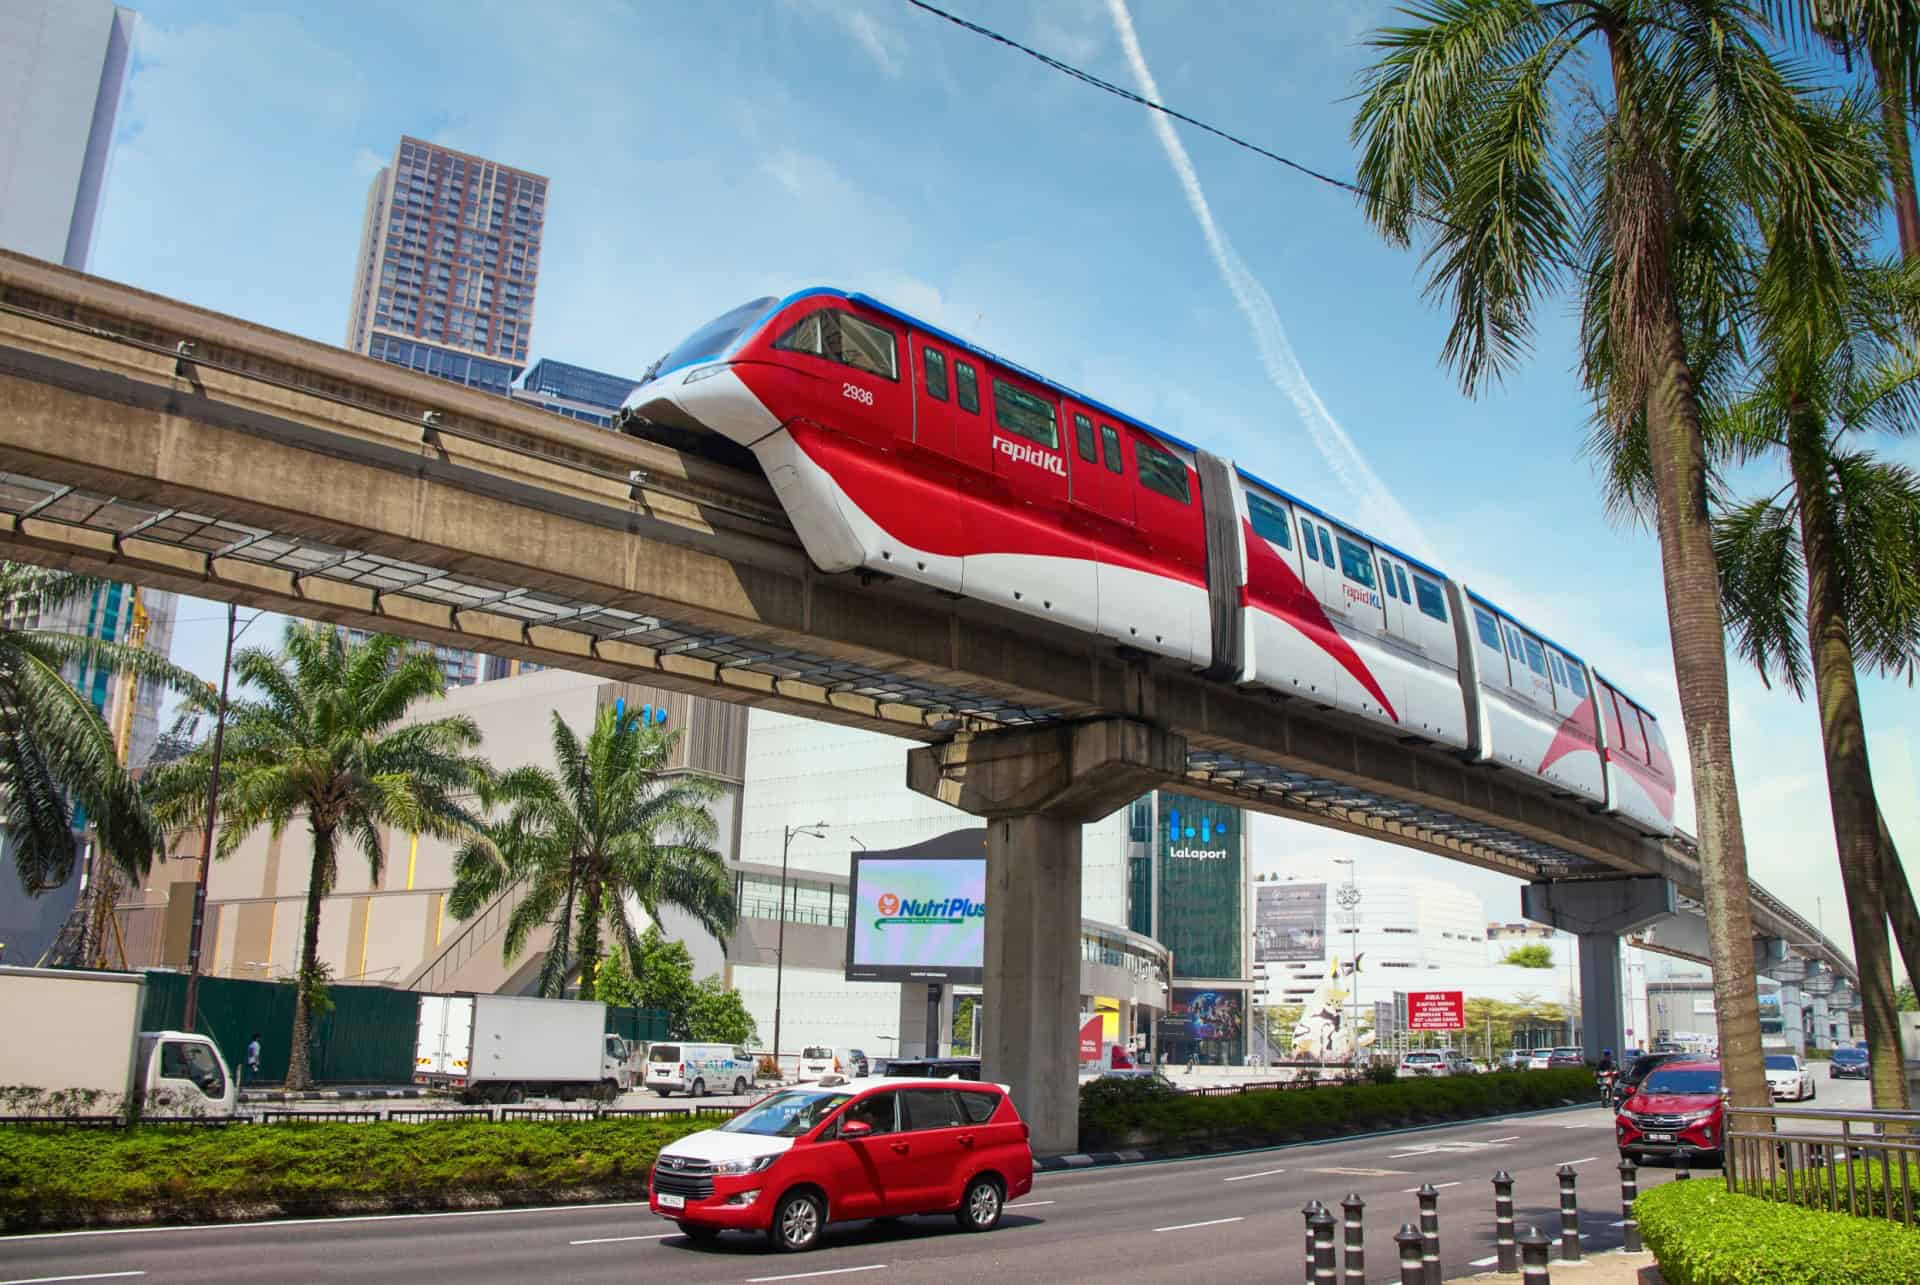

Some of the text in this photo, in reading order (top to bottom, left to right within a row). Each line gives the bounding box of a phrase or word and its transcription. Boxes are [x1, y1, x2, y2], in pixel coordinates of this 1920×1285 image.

[992, 435, 1067, 477] rapidKL
[1343, 583, 1382, 610] rapidKL
[1170, 846, 1226, 861] LaLaport
